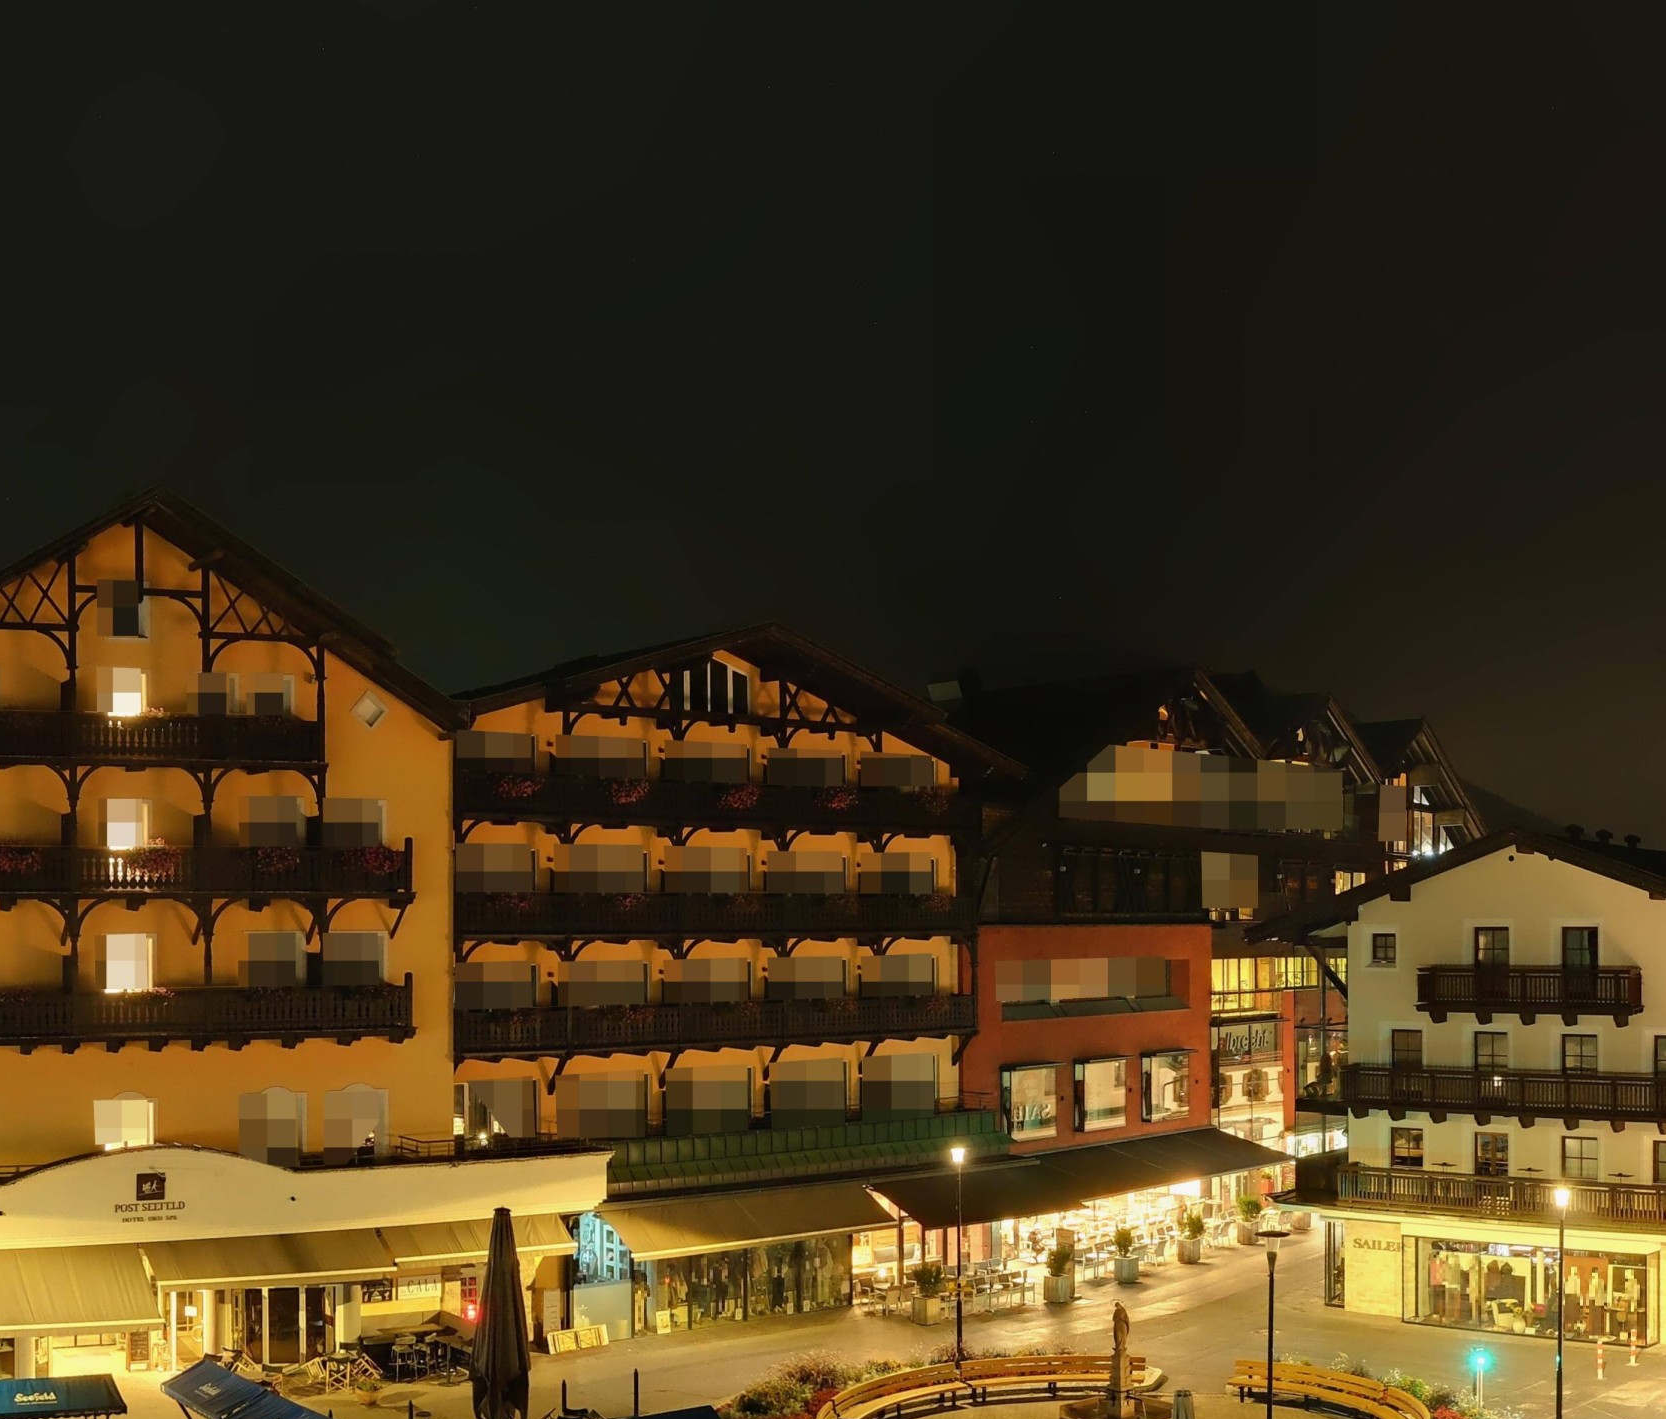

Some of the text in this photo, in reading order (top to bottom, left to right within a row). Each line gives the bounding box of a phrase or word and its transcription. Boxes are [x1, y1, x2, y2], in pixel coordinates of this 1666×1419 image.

[115, 1201, 185, 1213] POST SEEFELD
[408, 1278, 437, 1293] CALA
[14, 1392, 57, 1403] Seefeld
